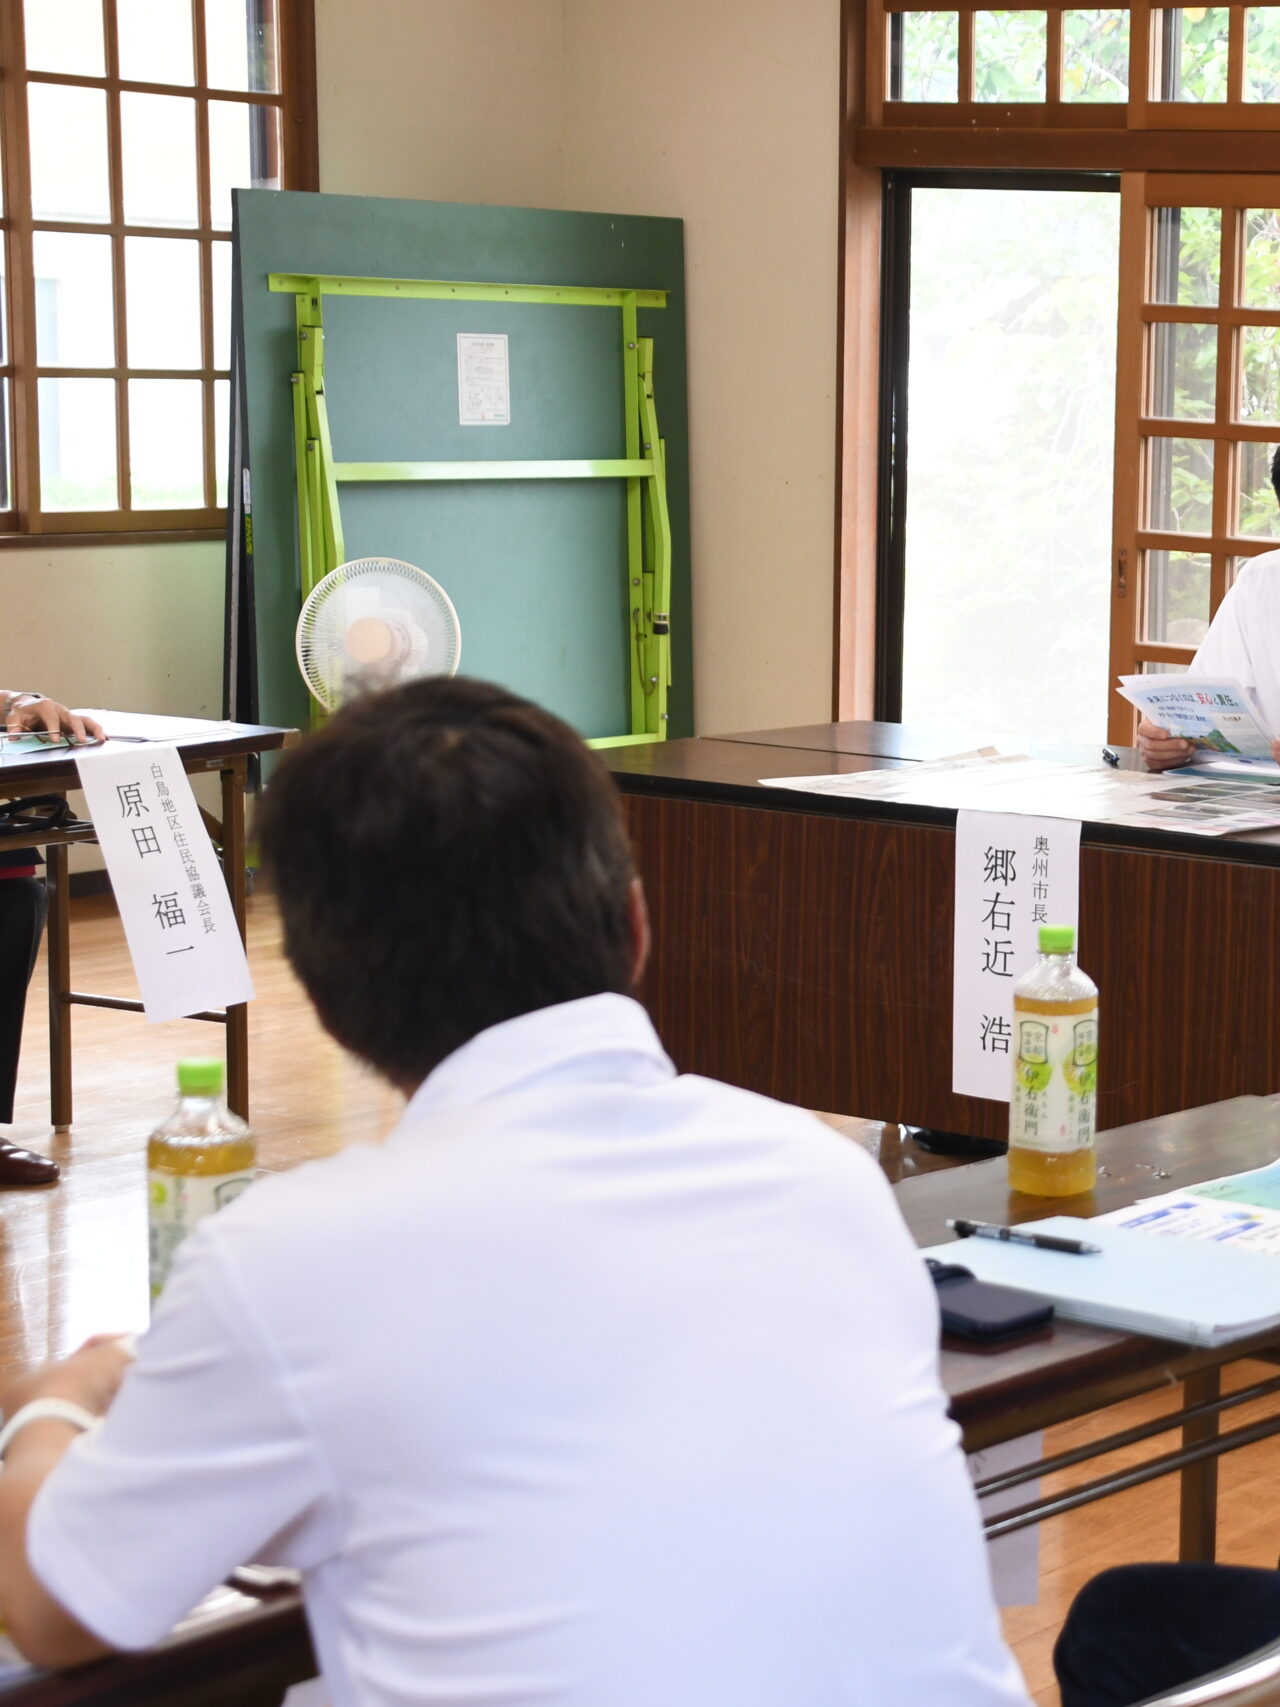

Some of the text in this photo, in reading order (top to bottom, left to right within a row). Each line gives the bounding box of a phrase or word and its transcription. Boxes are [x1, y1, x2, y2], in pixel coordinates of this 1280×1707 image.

[116, 781, 195, 956] 原田 福一
[150, 762, 217, 934] 白鳥地区住民協議会長
[1031, 834, 1050, 924] 奥州市長
[979, 845, 1017, 1055] 郷右近 浩
[1024, 1067, 1041, 1136] 伊右衛門
